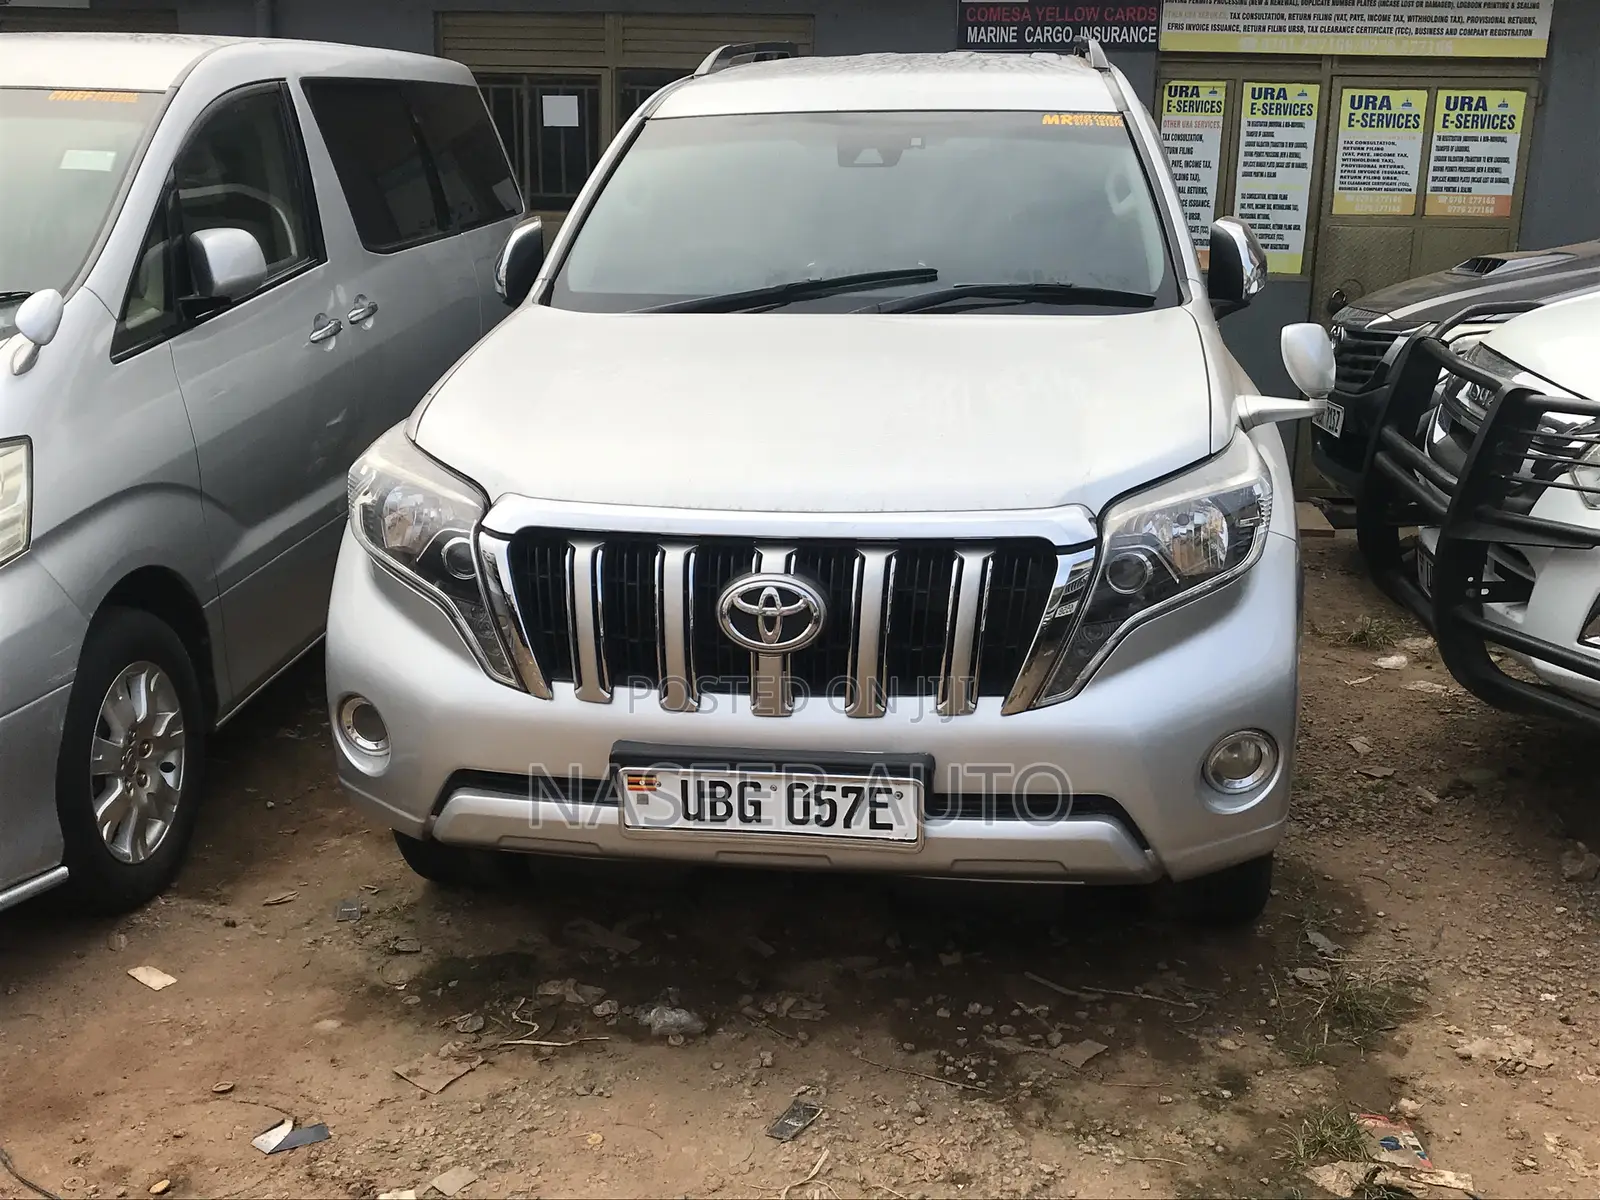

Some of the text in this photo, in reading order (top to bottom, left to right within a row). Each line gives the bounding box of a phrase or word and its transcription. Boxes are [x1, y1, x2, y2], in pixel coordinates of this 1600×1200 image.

[1415, 0, 1424, 8] OR
[1483, 1, 1509, 9] PRINTING
[1510, 1, 1515, 9] &
[1516, 1, 1540, 9] SEALING
[966, 7, 1157, 22] COMESA YELLOW CARDS
[1230, 12, 1241, 20] TAX
[1242, 12, 1287, 21] CONSULTATION,
[1287, 12, 1312, 21] RETURN
[1312, 13, 1332, 22] FILING
[1349, 13, 1366, 22] PAYE,
[1367, 14, 1392, 23] INCOME
[1392, 14, 1405, 23] TAX,
[1407, 14, 1448, 24] WITHHOLDING
[1466, 15, 1506, 25] PROVISIONAL
[1507, 16, 1537, 25] RETURNS,
[967, 26, 1157, 43] MARINE CARGO INSURANCE
[1167, 22, 1184, 31] EFRIS
[1185, 23, 1209, 31] INVOICE
[1210, 23, 1241, 32] ISSUANCE,
[1242, 24, 1266, 32] RETURN
[1267, 24, 1287, 33] FILING
[1307, 25, 1319, 33] TAX
[1319, 25, 1354, 34] CLEARANCE
[1356, 26, 1394, 35] CERTIFICATE
[1415, 27, 1444, 36] BUSINESS
[1444, 27, 1458, 36] AND
[1459, 27, 1489, 36] COMPANY
[1489, 28, 1533, 37] REGISTRATION
[1168, 85, 1200, 98] URA
[1251, 87, 1288, 101] URA
[1166, 100, 1222, 114] E-SERVICES
[1250, 102, 1314, 117] E-SERVICES
[1350, 94, 1392, 111] URA
[1445, 96, 1488, 112] URA
[1042, 114, 1072, 125] MR
[1163, 120, 1181, 129] OTHER
[1347, 112, 1421, 130] E-SERVICES
[1441, 113, 1516, 130] E-SERVICES
[1179, 146, 1194, 155] FILING
[680, 779, 894, 831] UBG 057E
